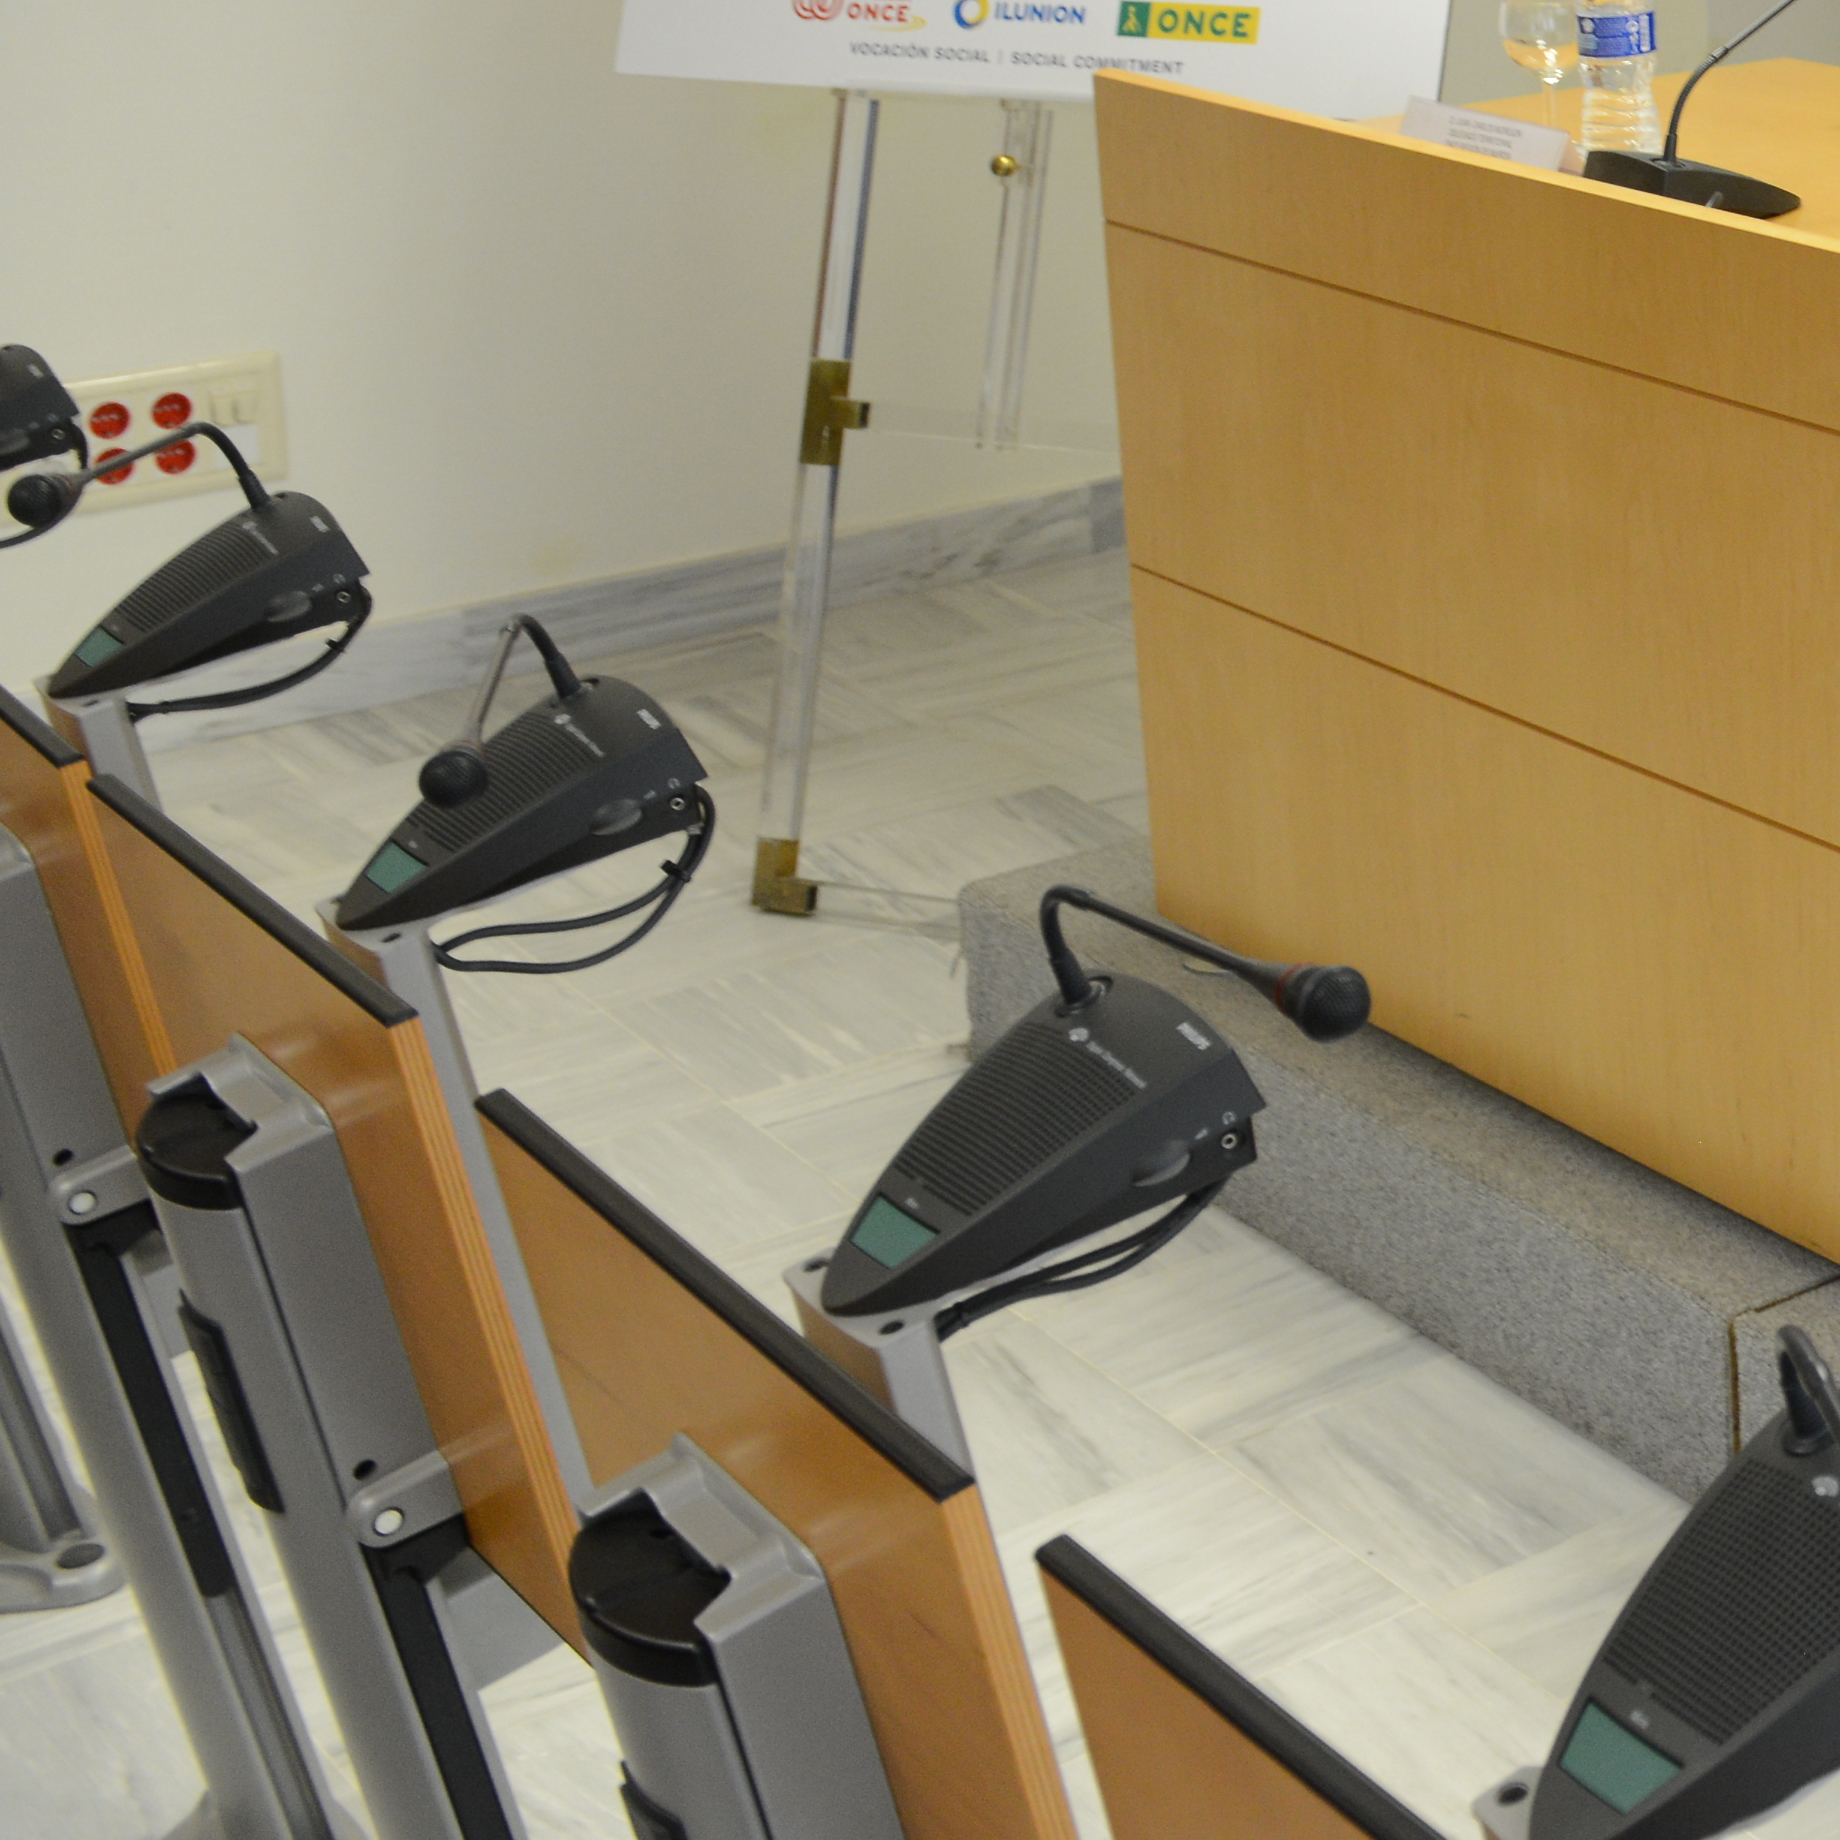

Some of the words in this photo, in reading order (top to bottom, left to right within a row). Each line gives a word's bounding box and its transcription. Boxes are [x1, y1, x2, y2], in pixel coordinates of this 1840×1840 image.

[846, 3, 910, 24] ONCE
[994, 1, 1087, 25] ILUNION
[1157, 8, 1252, 38] ONCE
[849, 40, 931, 59] VOCACIÓN
[934, 46, 990, 63] SOCIAL
[1011, 51, 1067, 68] SOCIAL
[1073, 56, 1185, 75] COMMITMENT
